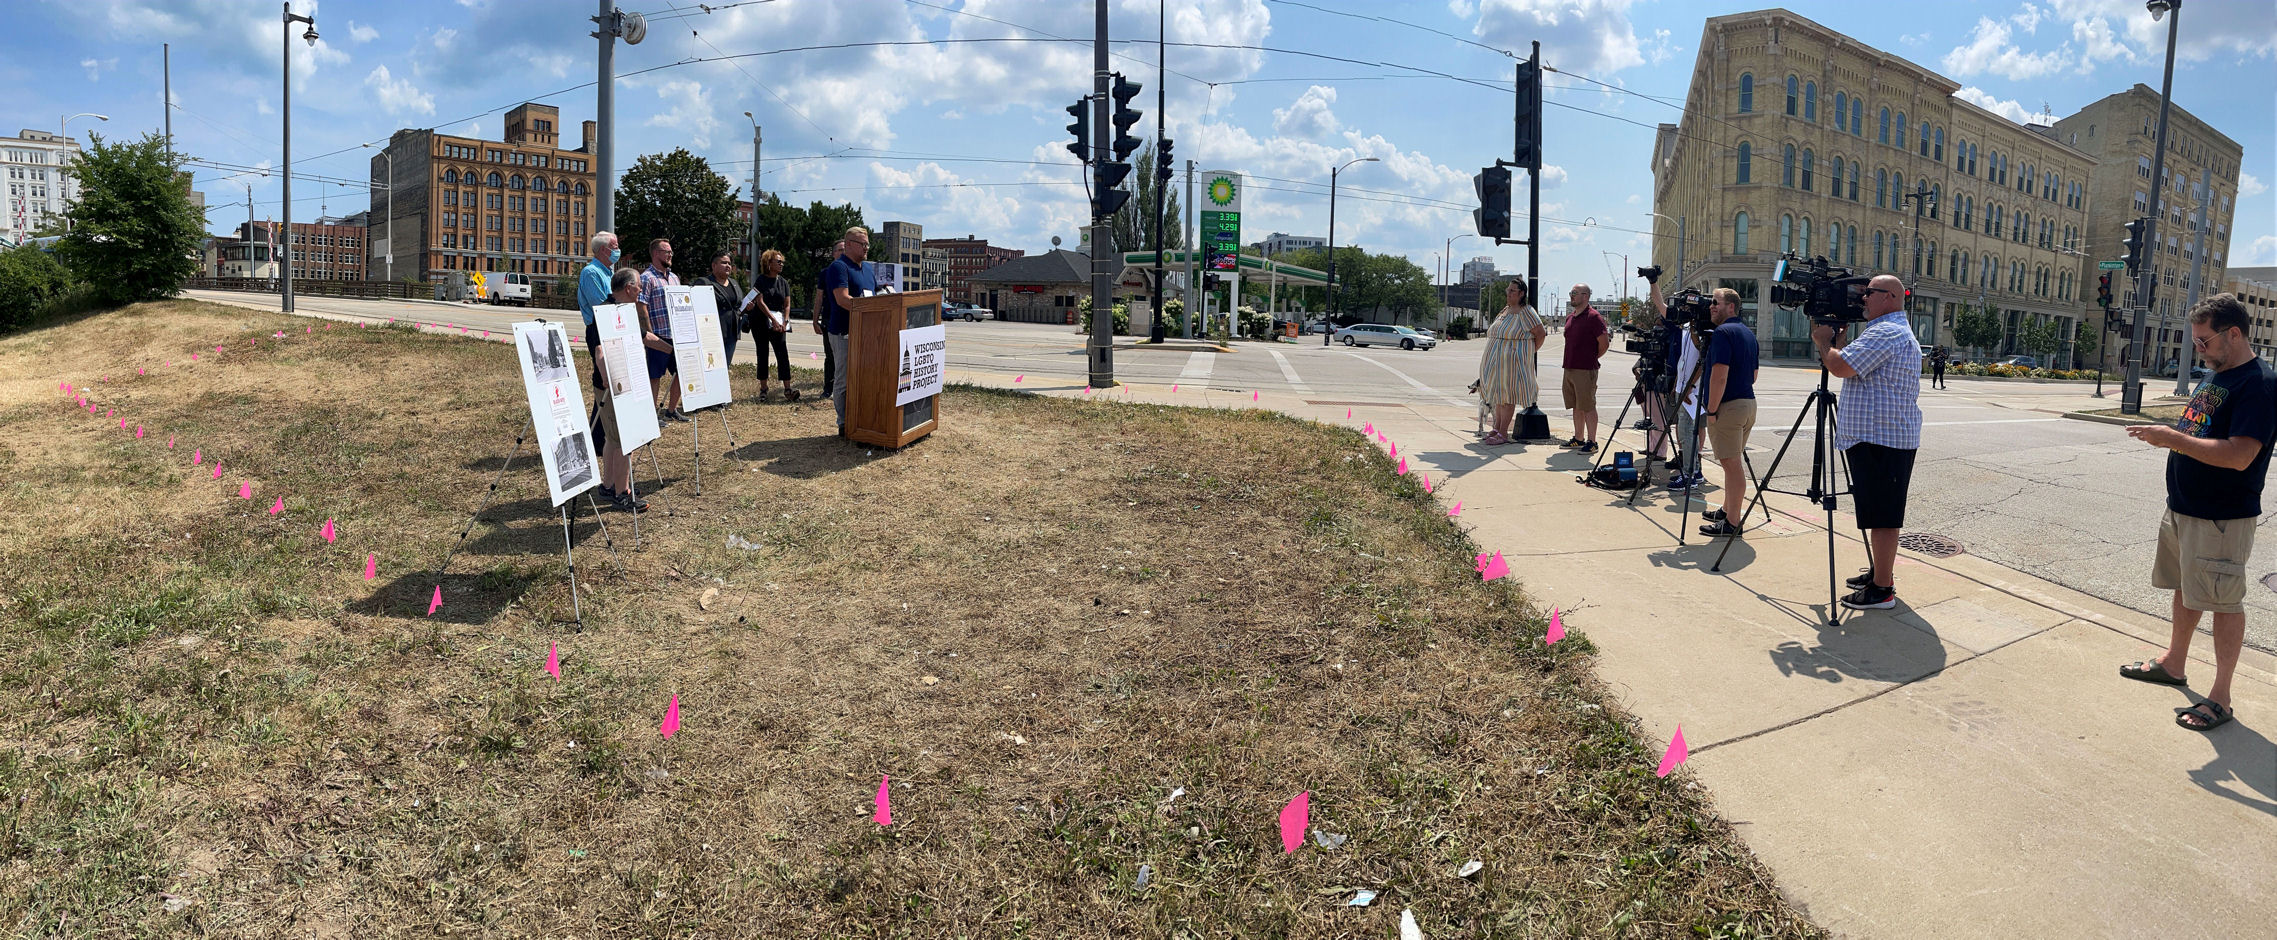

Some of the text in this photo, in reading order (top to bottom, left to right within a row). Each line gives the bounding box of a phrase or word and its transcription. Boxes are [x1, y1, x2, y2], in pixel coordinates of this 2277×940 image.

[914, 340, 945, 354] WISCONSIN
[914, 354, 934, 366] LGBTQ
[913, 363, 938, 378] HISTORY
[912, 374, 938, 390] PROJECT
